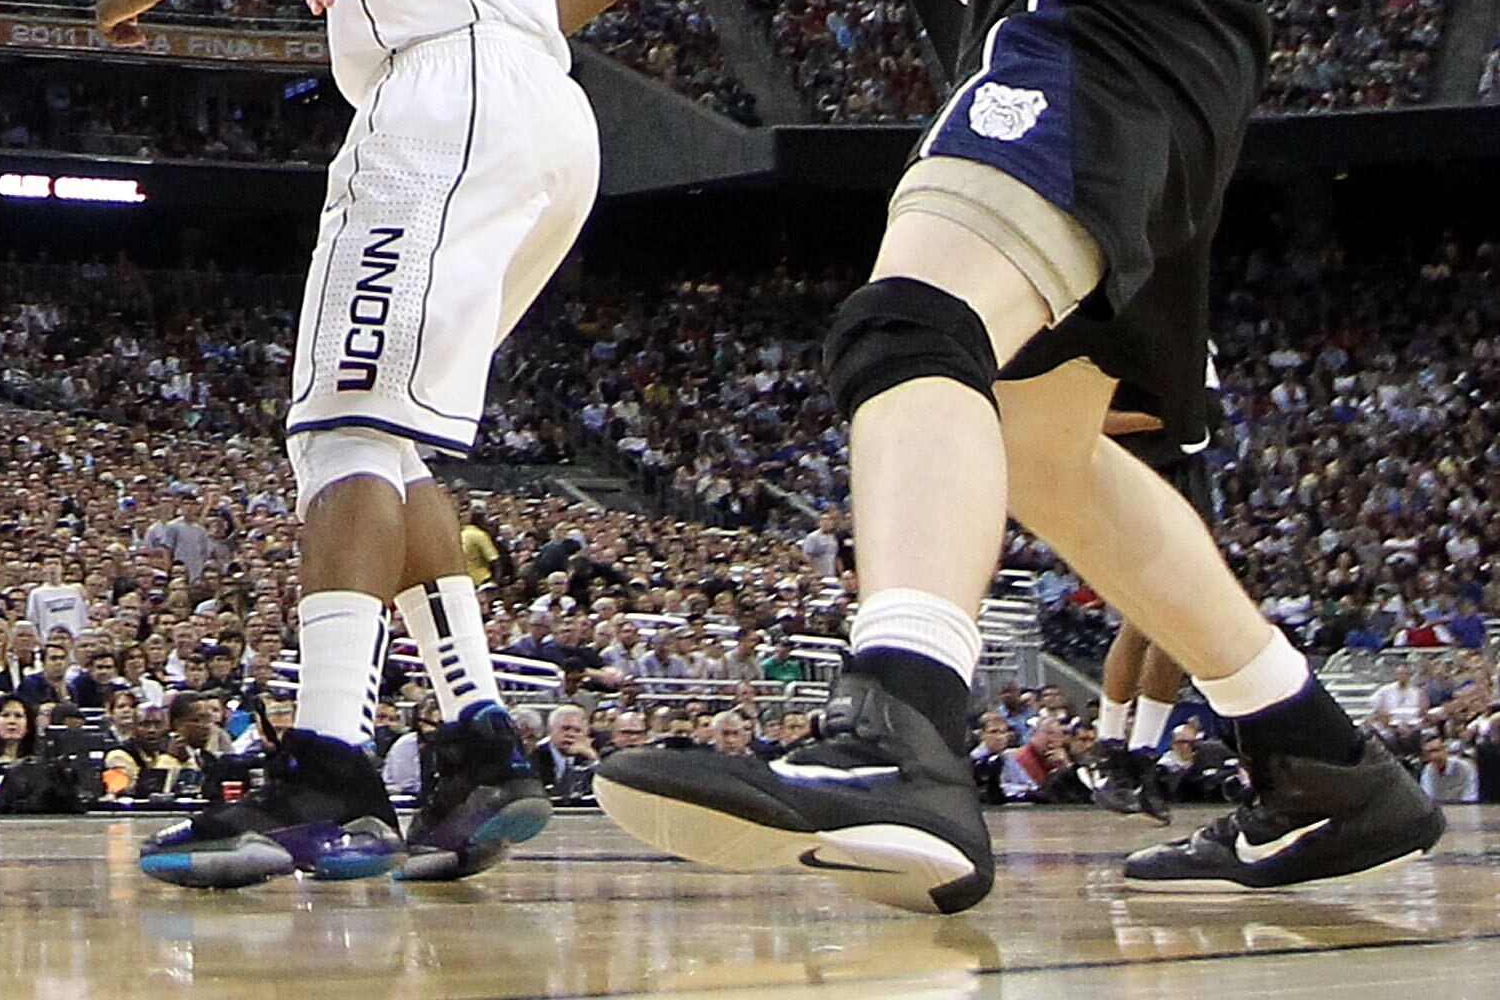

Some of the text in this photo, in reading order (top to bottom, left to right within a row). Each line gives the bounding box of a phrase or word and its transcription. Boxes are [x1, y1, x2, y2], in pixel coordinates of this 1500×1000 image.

[10, 23, 77, 45] 2011
[188, 36, 276, 58] FINAL
[337, 227, 405, 392] UCONN
